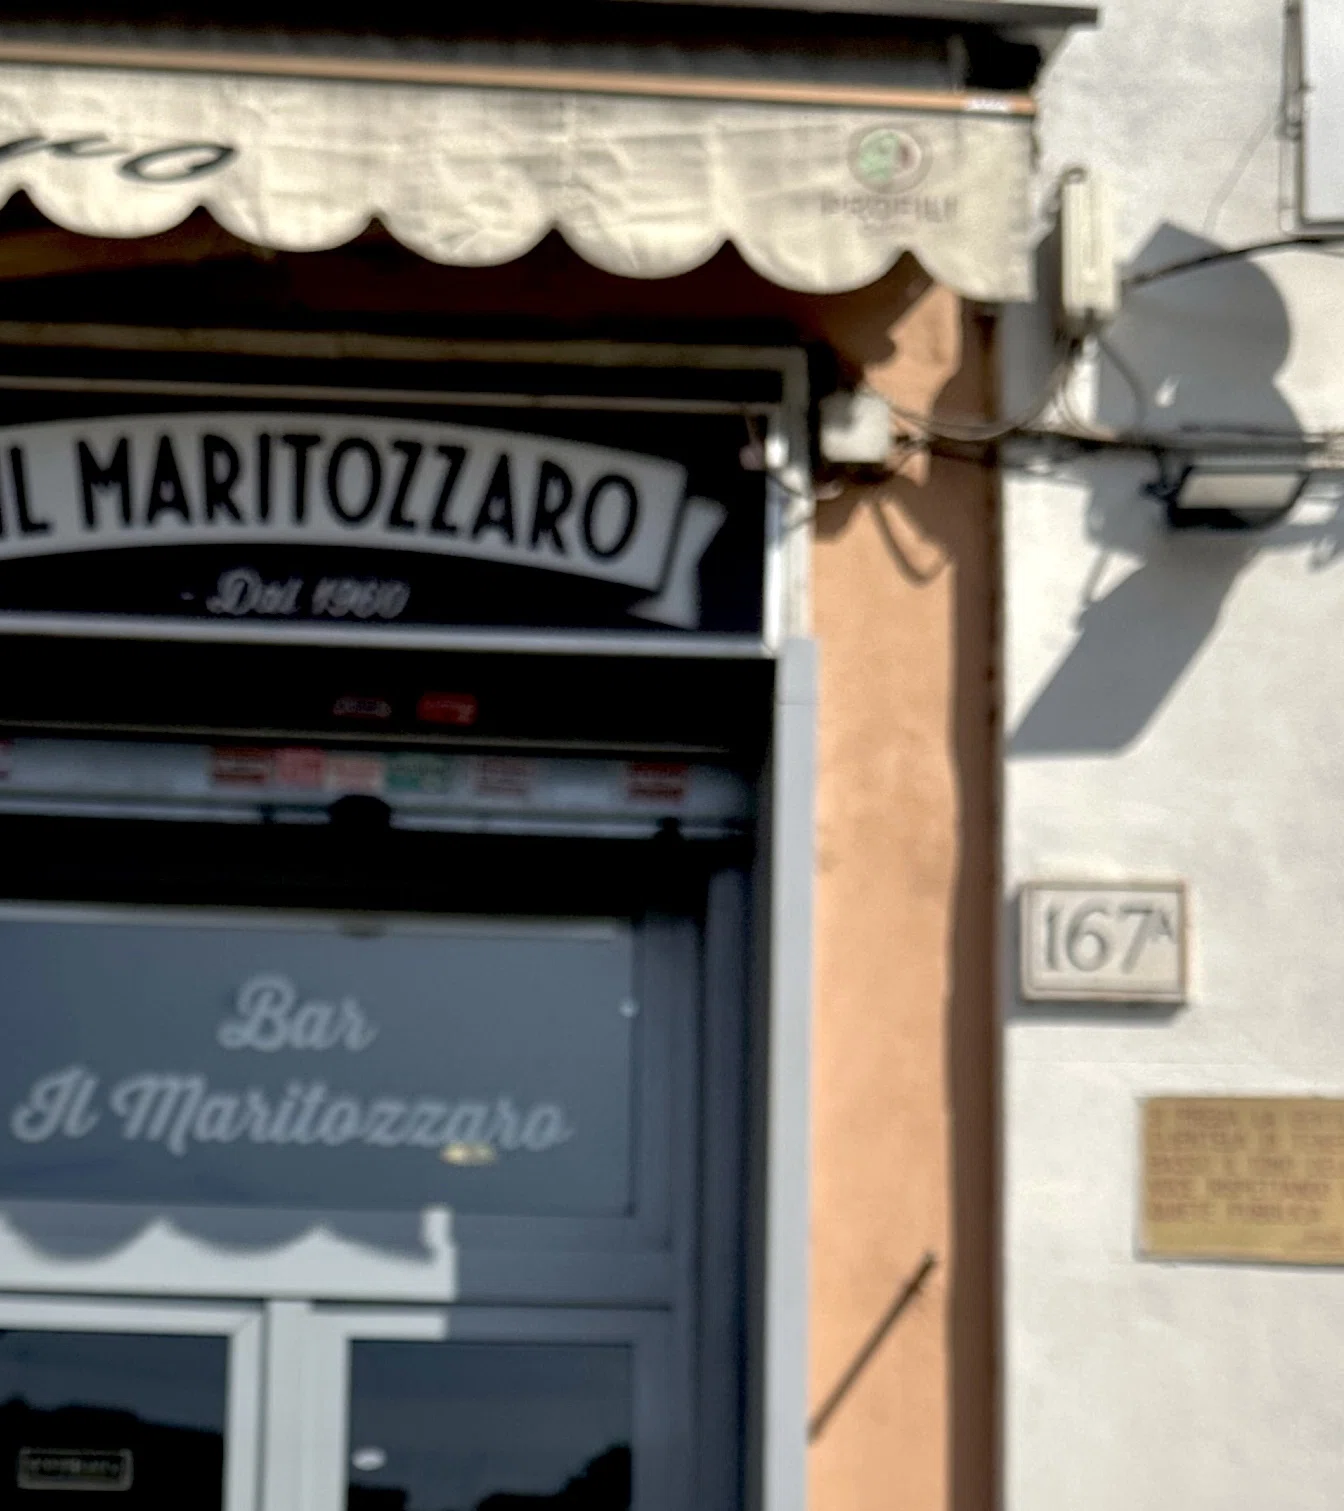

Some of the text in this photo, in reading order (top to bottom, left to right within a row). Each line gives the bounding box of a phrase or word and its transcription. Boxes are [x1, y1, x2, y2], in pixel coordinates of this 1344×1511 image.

[76, 431, 639, 563] MARITOZZARO
[205, 568, 302, 615] Dal
[218, 974, 378, 1052] Bar
[13, 1066, 572, 1155] Il Maritozzaro
